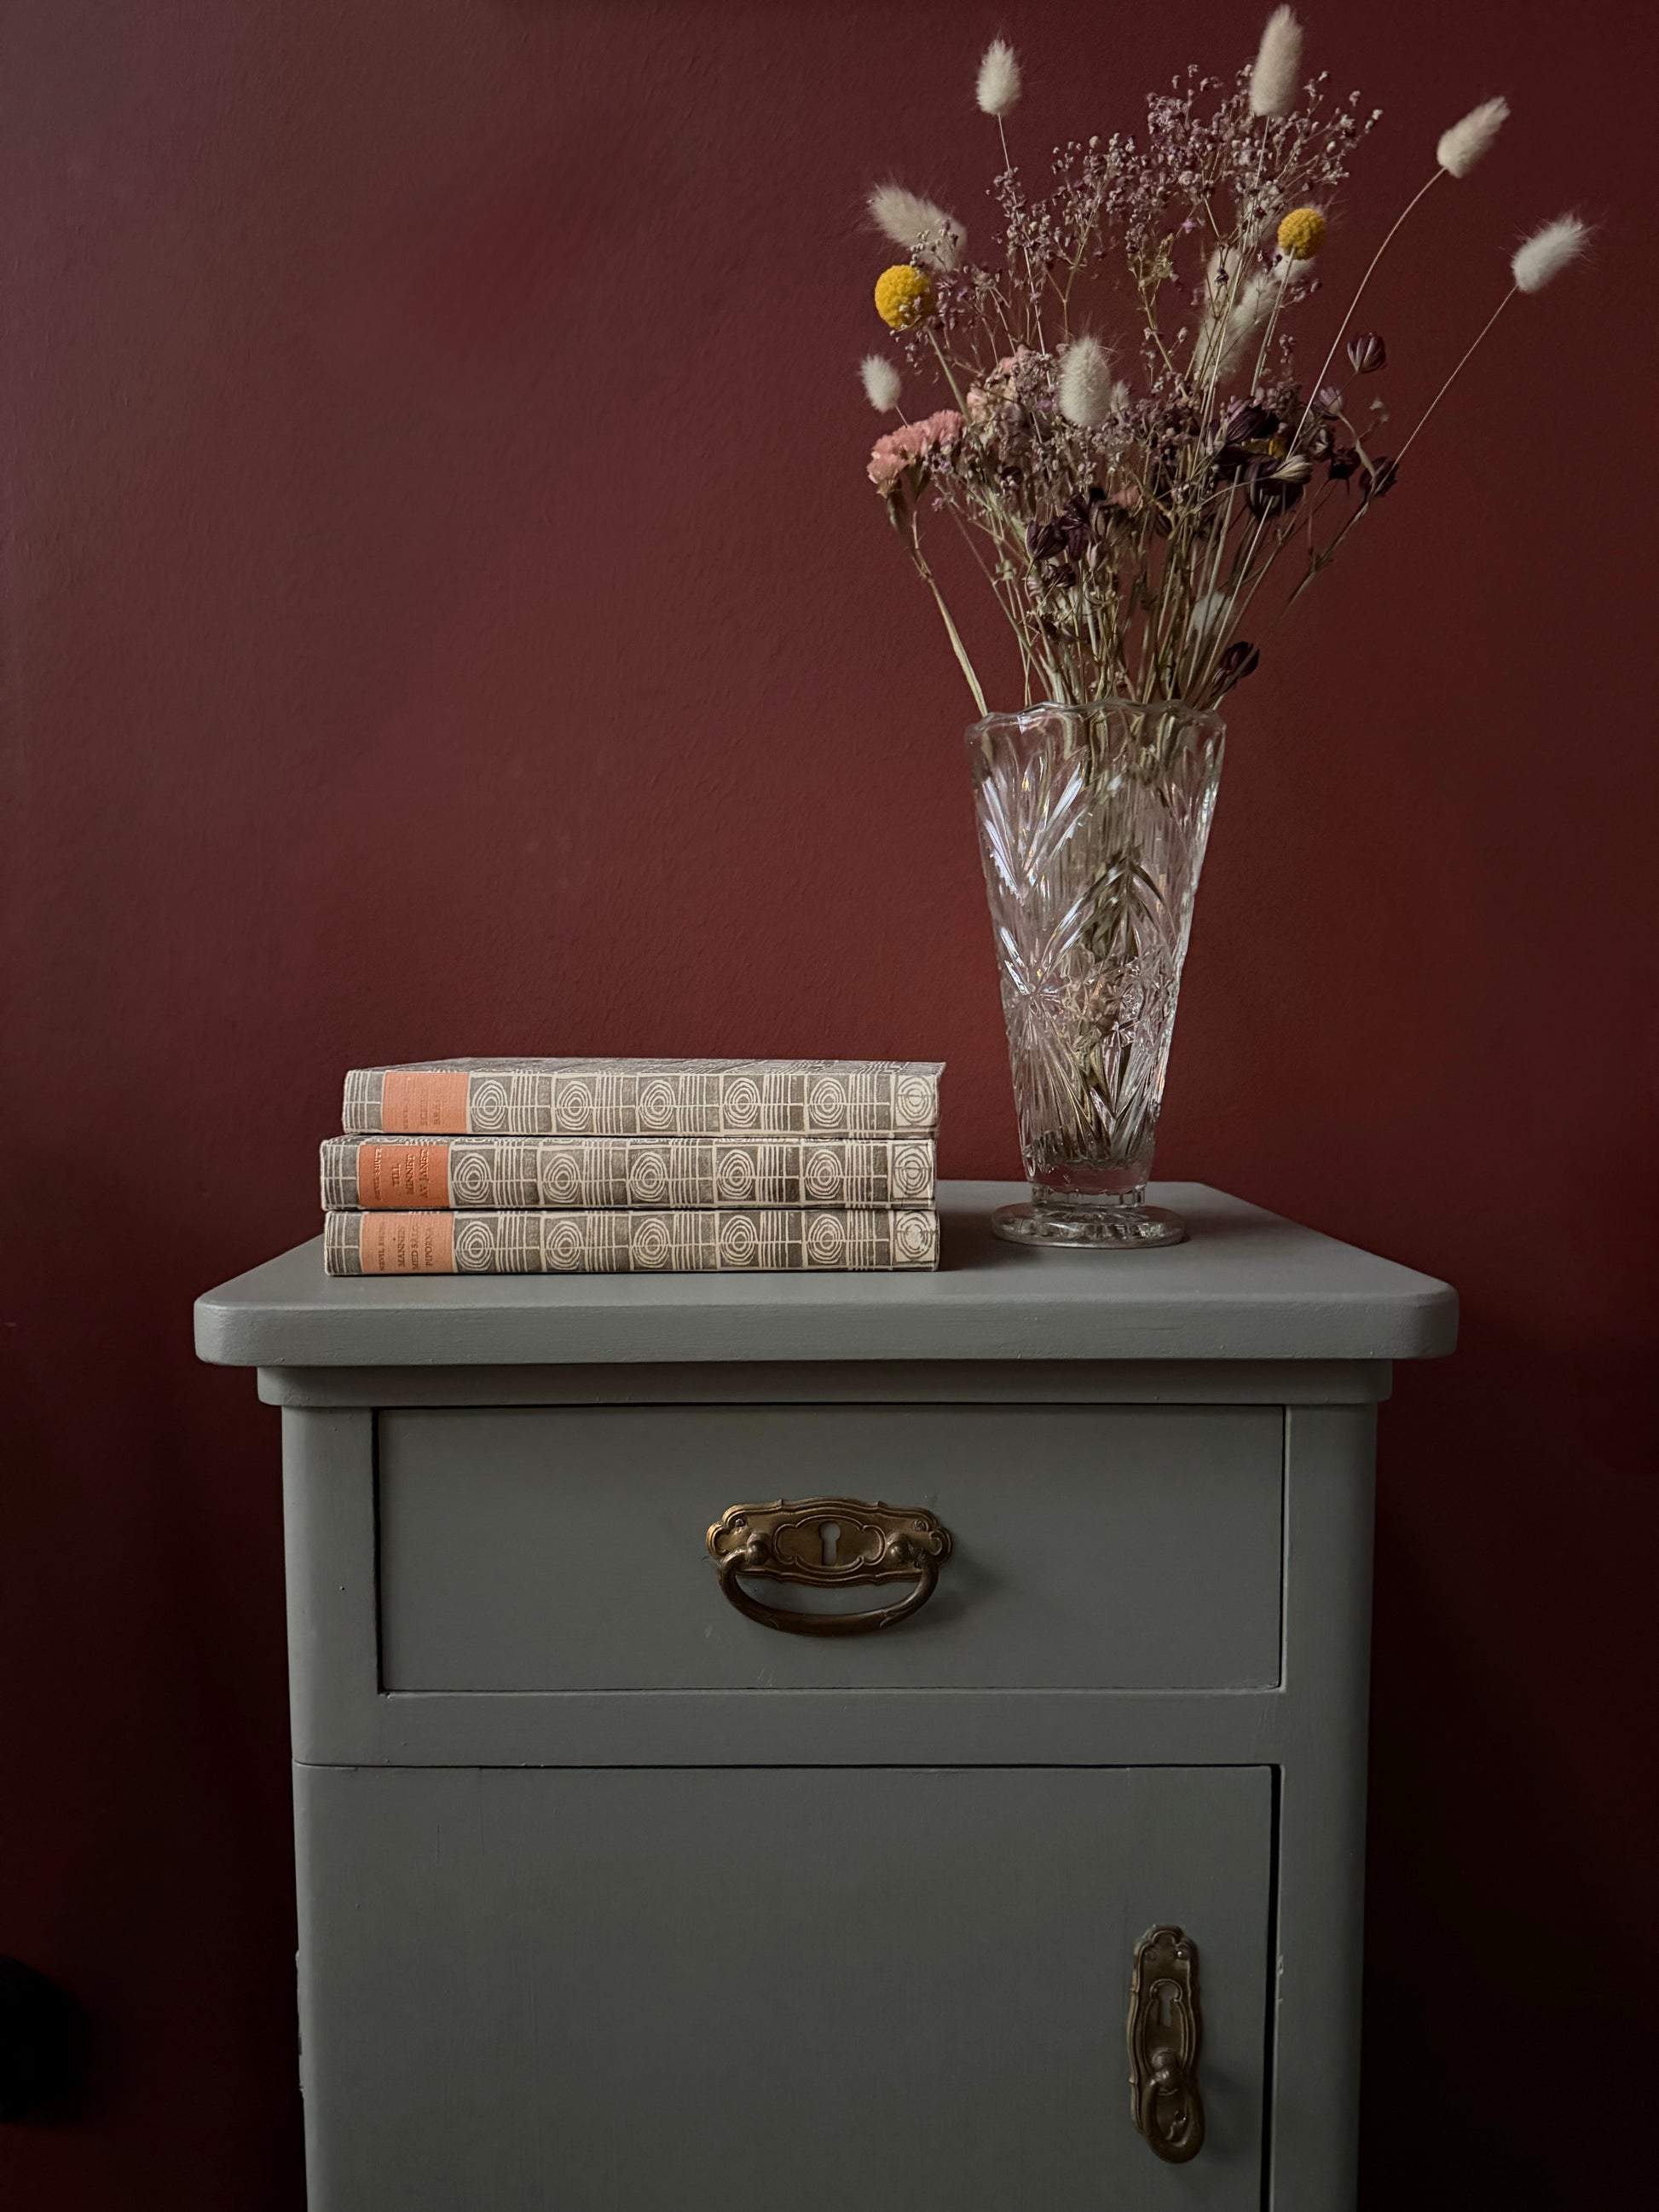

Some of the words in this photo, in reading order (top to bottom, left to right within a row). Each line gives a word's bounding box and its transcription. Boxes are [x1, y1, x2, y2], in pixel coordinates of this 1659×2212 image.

[391, 1164, 401, 1187] TILL
[406, 1153, 414, 1195] MINNET
[419, 1149, 430, 1184] JANET
[397, 1226, 406, 1268] MANNEN
[411, 1250, 419, 1271] MED
[425, 1227, 433, 1268] PIPORNA
